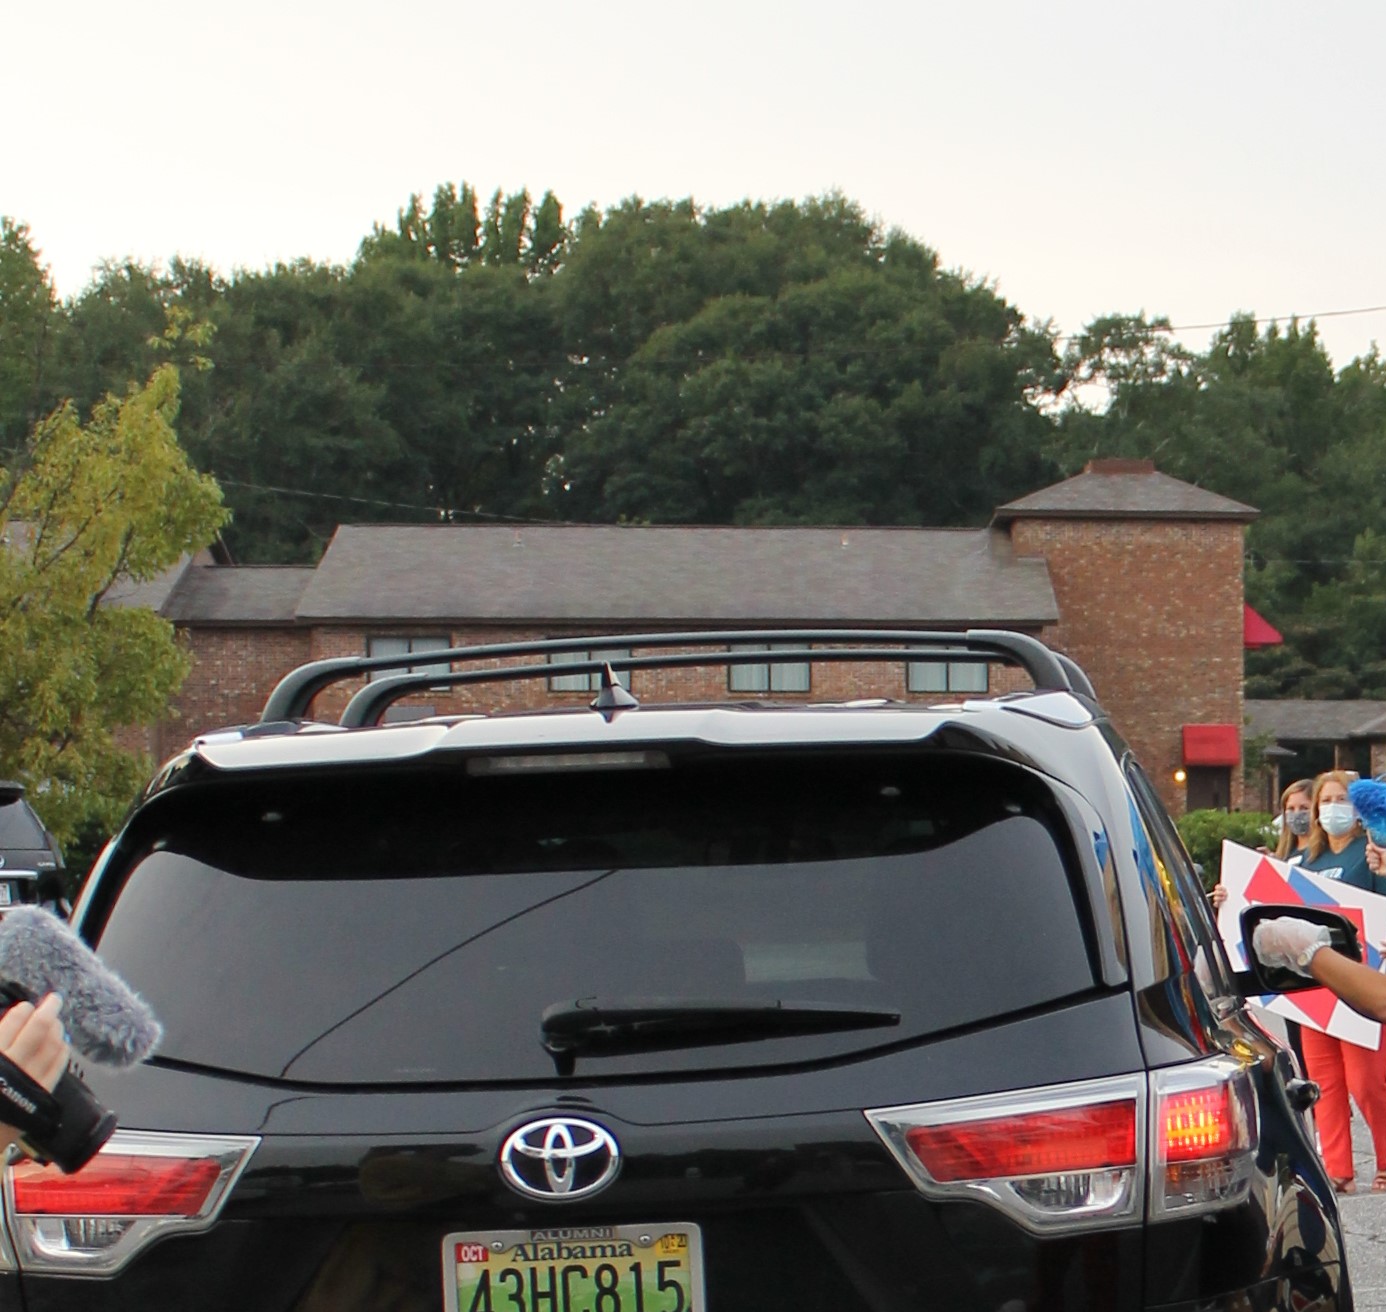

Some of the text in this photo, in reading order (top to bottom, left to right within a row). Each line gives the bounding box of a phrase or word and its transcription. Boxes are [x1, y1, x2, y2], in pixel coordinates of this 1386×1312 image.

[530, 1228, 613, 1241] ALUMNI
[460, 1245, 485, 1262] OCT
[511, 1243, 634, 1262] Alabama
